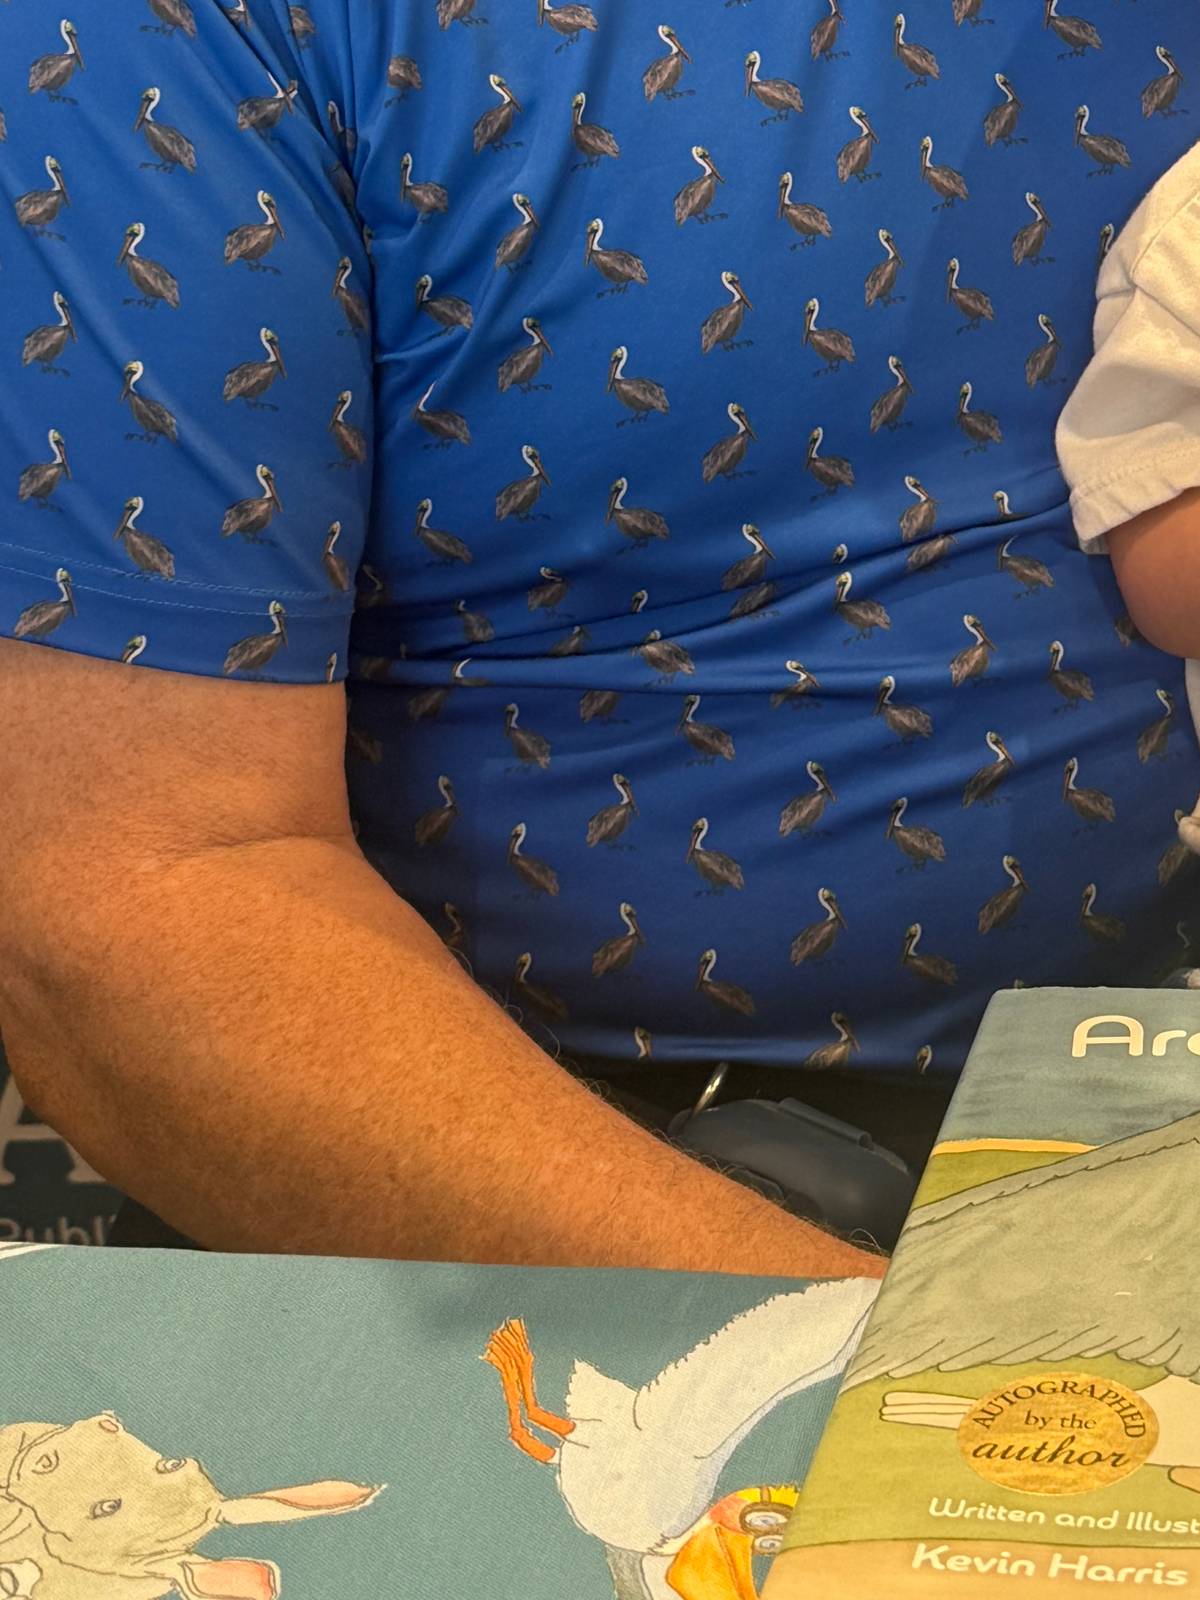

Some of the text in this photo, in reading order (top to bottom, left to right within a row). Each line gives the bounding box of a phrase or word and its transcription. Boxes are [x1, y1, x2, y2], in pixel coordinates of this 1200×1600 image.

[972, 1380, 1147, 1438] AUTOGRAPHED
[1024, 1410, 1097, 1430] by the
[972, 1435, 1130, 1468] author
[929, 1497, 1045, 1525] Written
[1054, 1509, 1119, 1530] and
[911, 1542, 1189, 1586] Kevin Harris
